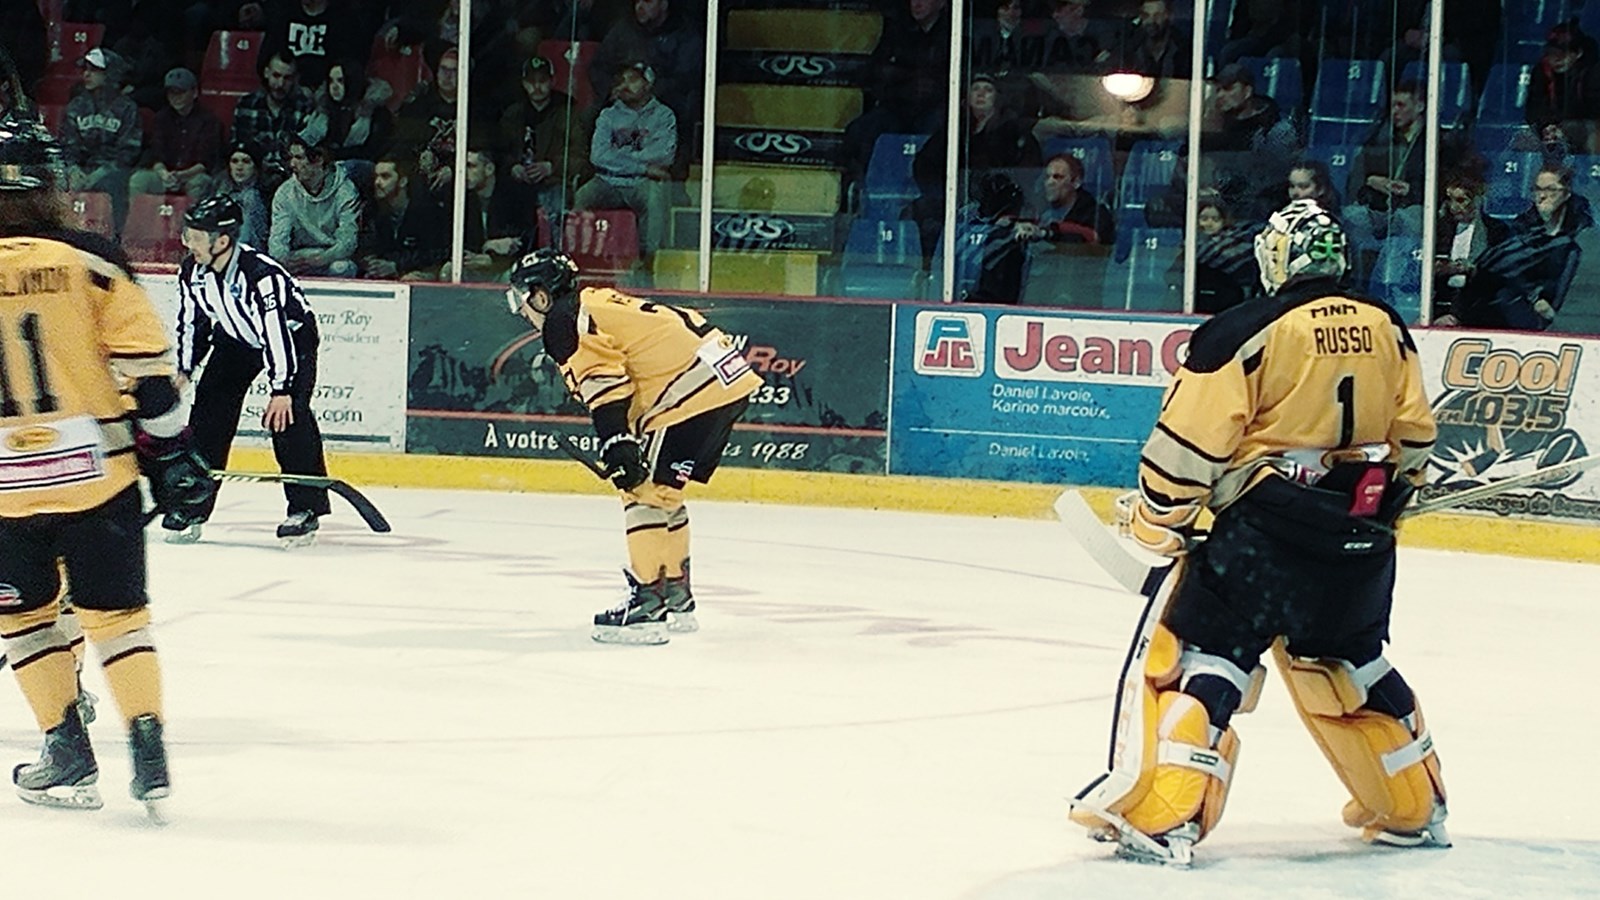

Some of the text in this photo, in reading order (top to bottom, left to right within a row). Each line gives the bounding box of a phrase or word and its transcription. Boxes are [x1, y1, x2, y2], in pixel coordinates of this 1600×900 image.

[746, 131, 801, 154] CRS
[727, 216, 782, 239] CRS
[339, 310, 372, 332] Roy
[1003, 321, 1153, 377] Jean
[1313, 325, 1374, 355] RUSSO
[1443, 339, 1582, 396] Cool
[992, 383, 1039, 399] Daniel
[1336, 375, 1355, 448] 1
[1464, 395, 1567, 431] 103.5
[484, 423, 499, 448] À
[751, 441, 809, 463] 1988
